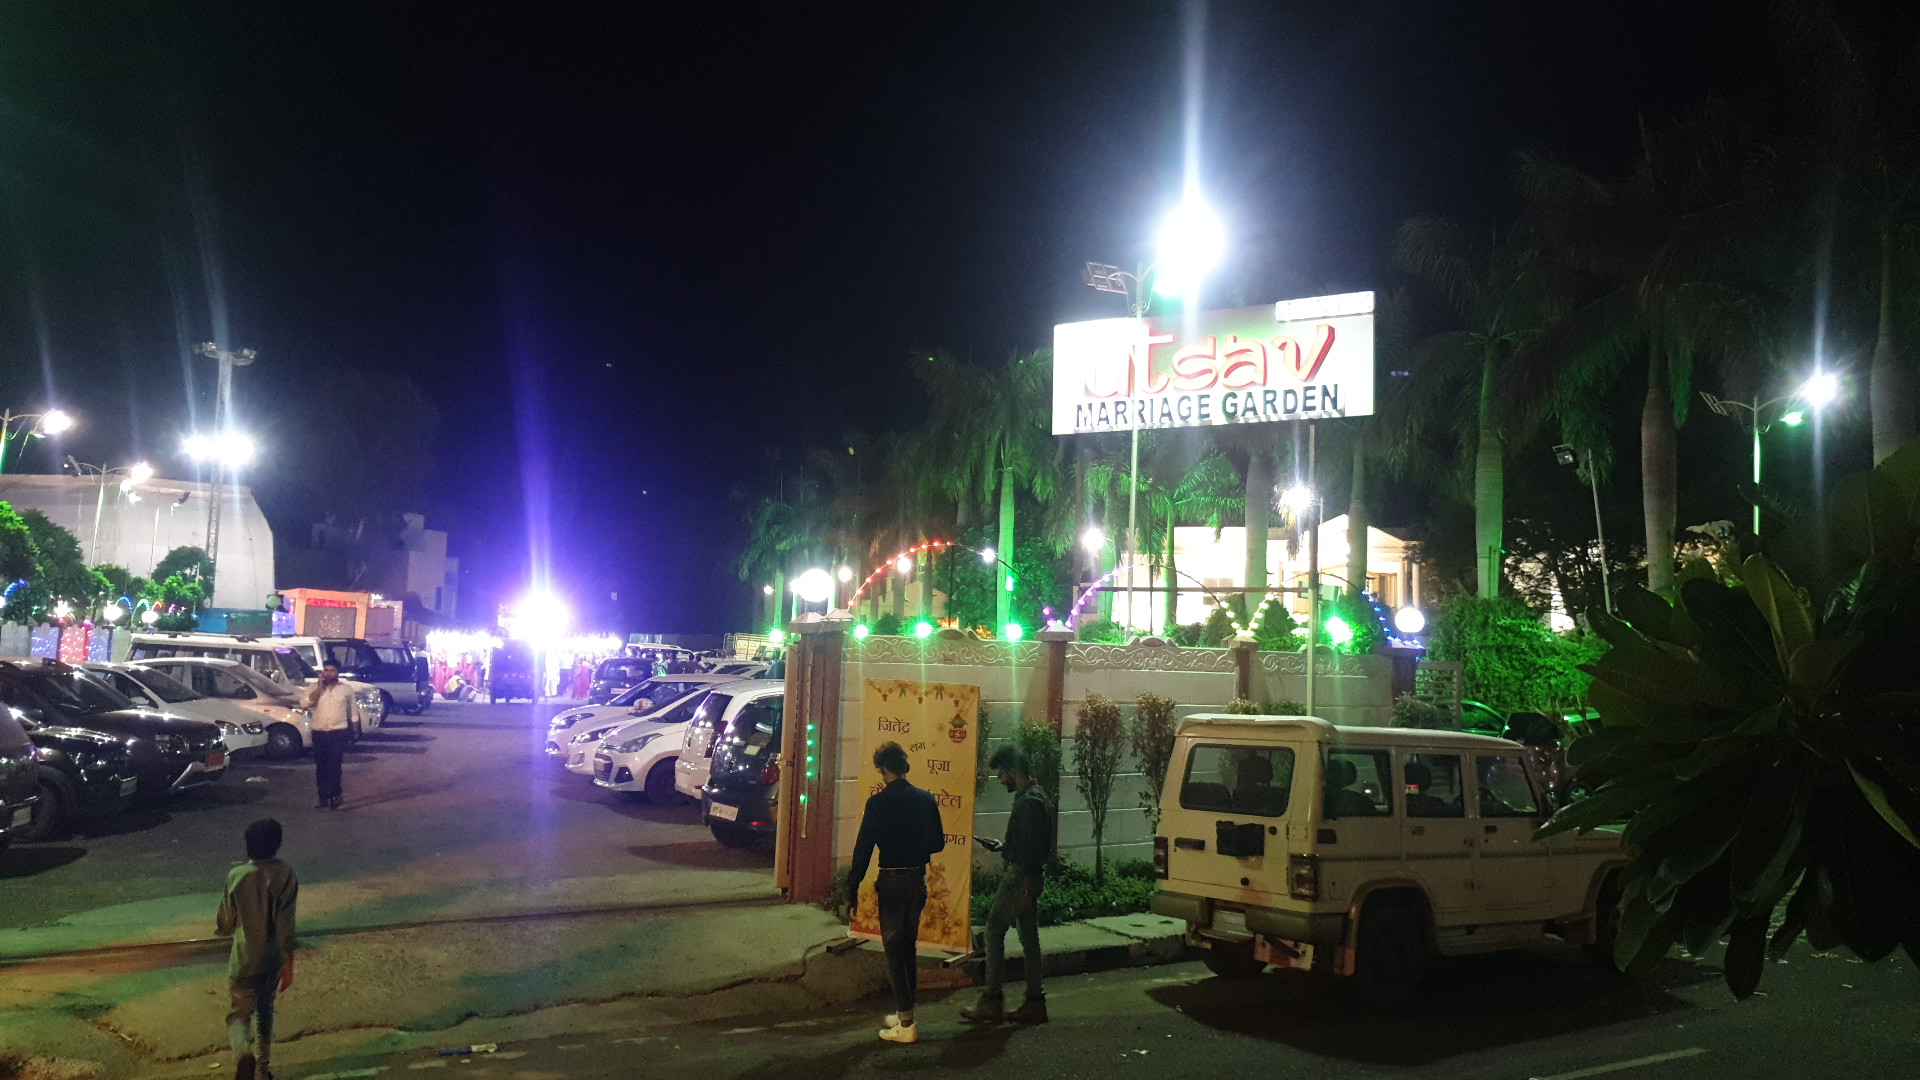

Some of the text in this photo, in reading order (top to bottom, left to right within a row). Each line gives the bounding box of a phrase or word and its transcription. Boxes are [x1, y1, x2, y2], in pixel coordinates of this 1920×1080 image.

[1075, 383, 1340, 428] MARRIAGE GARDEN
[878, 716, 910, 734] जितेंद्र
[909, 741, 926, 752] संग
[927, 759, 950, 774] पूजा
